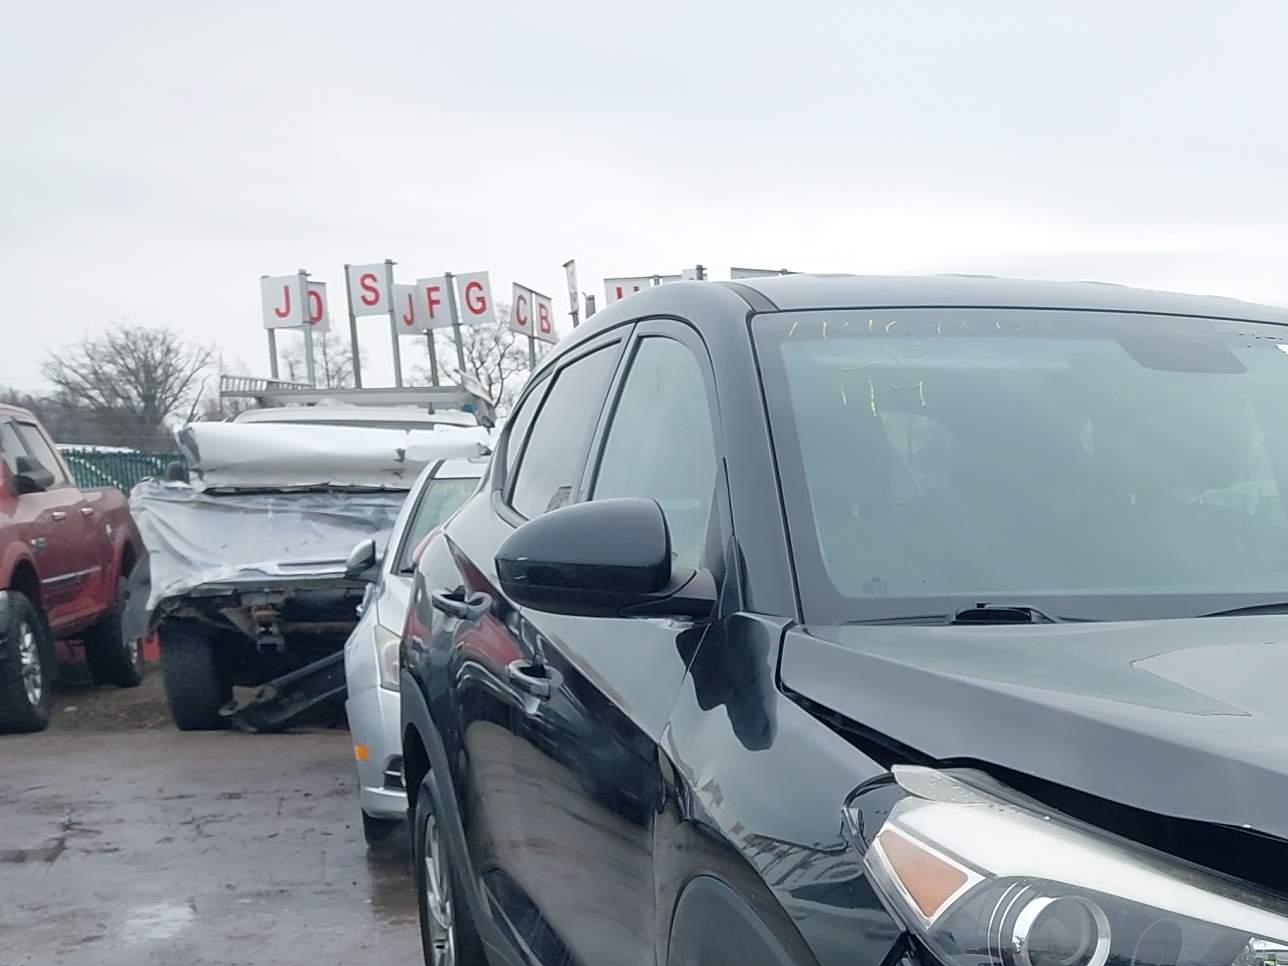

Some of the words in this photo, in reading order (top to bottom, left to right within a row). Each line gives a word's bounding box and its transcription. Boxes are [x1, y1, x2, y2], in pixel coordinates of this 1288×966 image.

[274, 285, 291, 318] J
[359, 273, 381, 306] S
[425, 286, 441, 319] F
[465, 281, 488, 315] G
[403, 293, 415, 326] J
[516, 293, 528, 326] C
[538, 303, 551, 334] B
